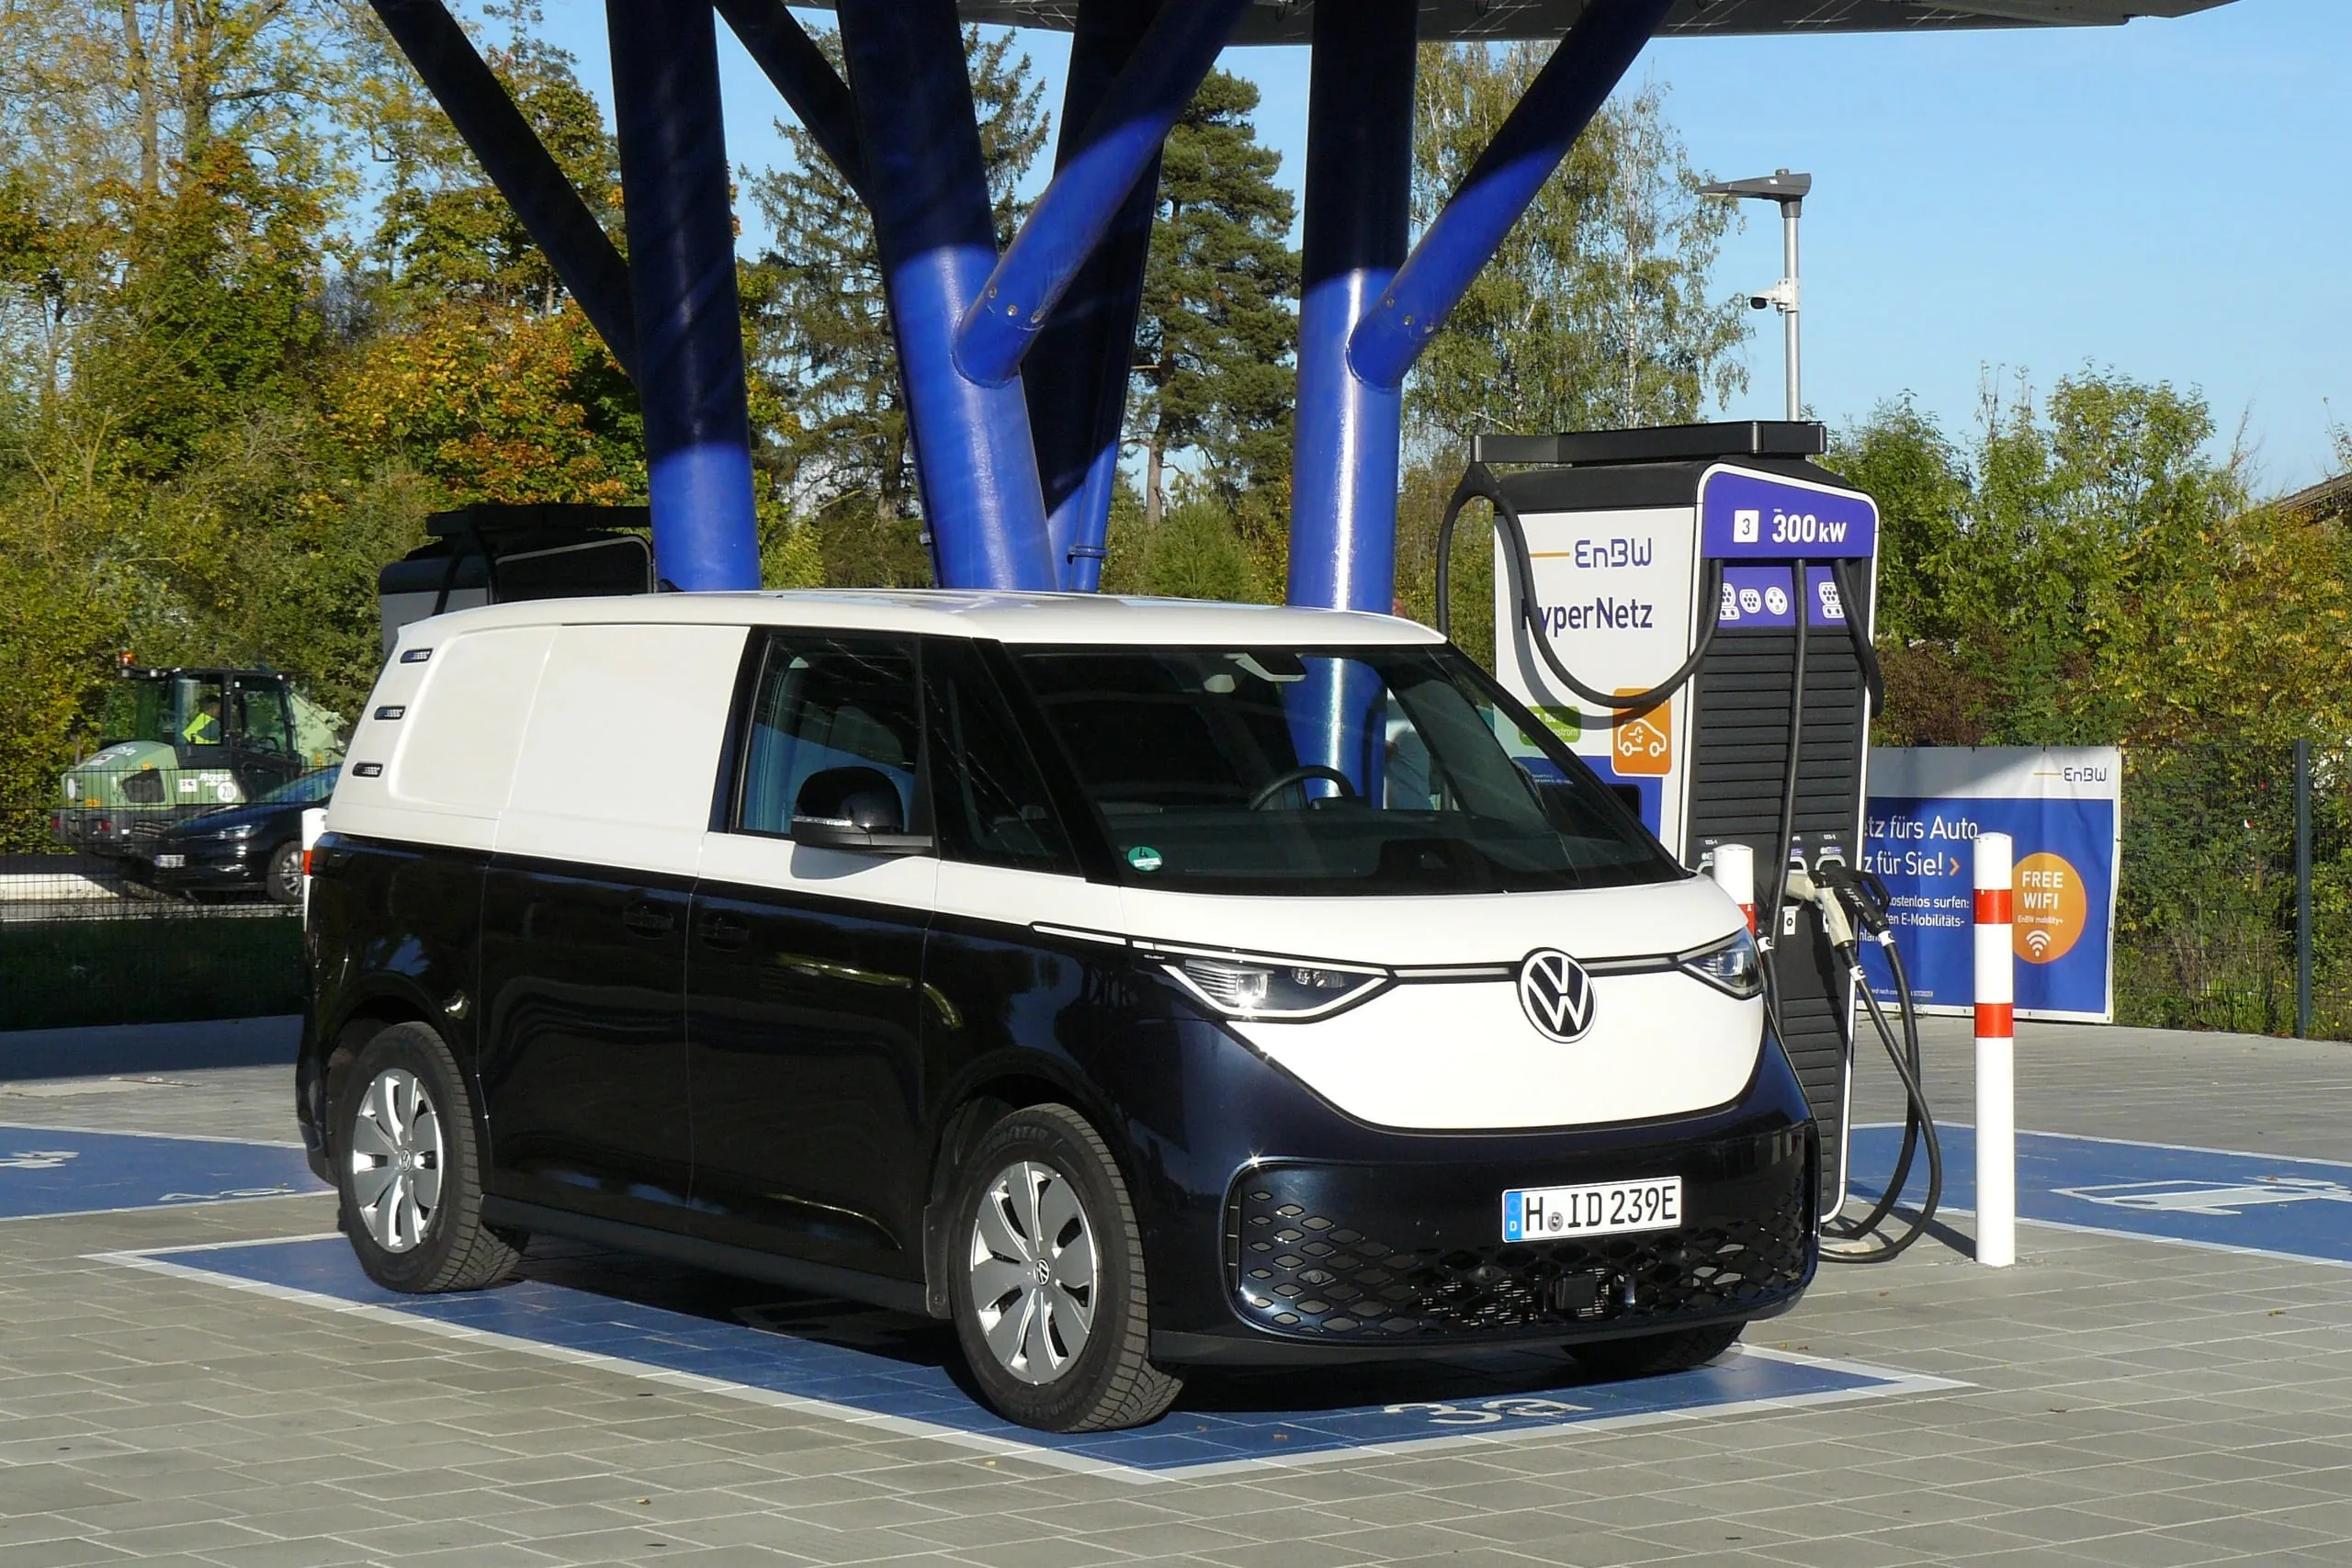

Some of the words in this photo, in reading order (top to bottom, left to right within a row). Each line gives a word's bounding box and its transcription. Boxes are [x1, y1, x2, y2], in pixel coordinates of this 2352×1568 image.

[1742, 518, 1750, 536] 3
[1771, 514, 1816, 543] 300
[1818, 522, 1847, 543] kW
[1575, 537, 1652, 569] EnBW
[2064, 767, 2107, 782] EnBW
[1864, 817, 1885, 838] tz
[1890, 815, 1924, 839] fürs
[1929, 815, 1978, 840] Auto
[1876, 851, 1901, 874] für
[1905, 851, 1943, 876] Sie!
[2021, 871, 2064, 888] FREE
[1890, 896, 1930, 908] ostenlos
[1933, 896, 1970, 908] surfen:
[2023, 892, 2059, 909] WIFI
[1901, 912, 1965, 927] E-Mobilitäts-
[1521, 952, 1595, 1039] VW
[1526, 1197, 1544, 1231] H
[1567, 1193, 1602, 1228] ID
[1610, 1186, 1677, 1224] 239E
